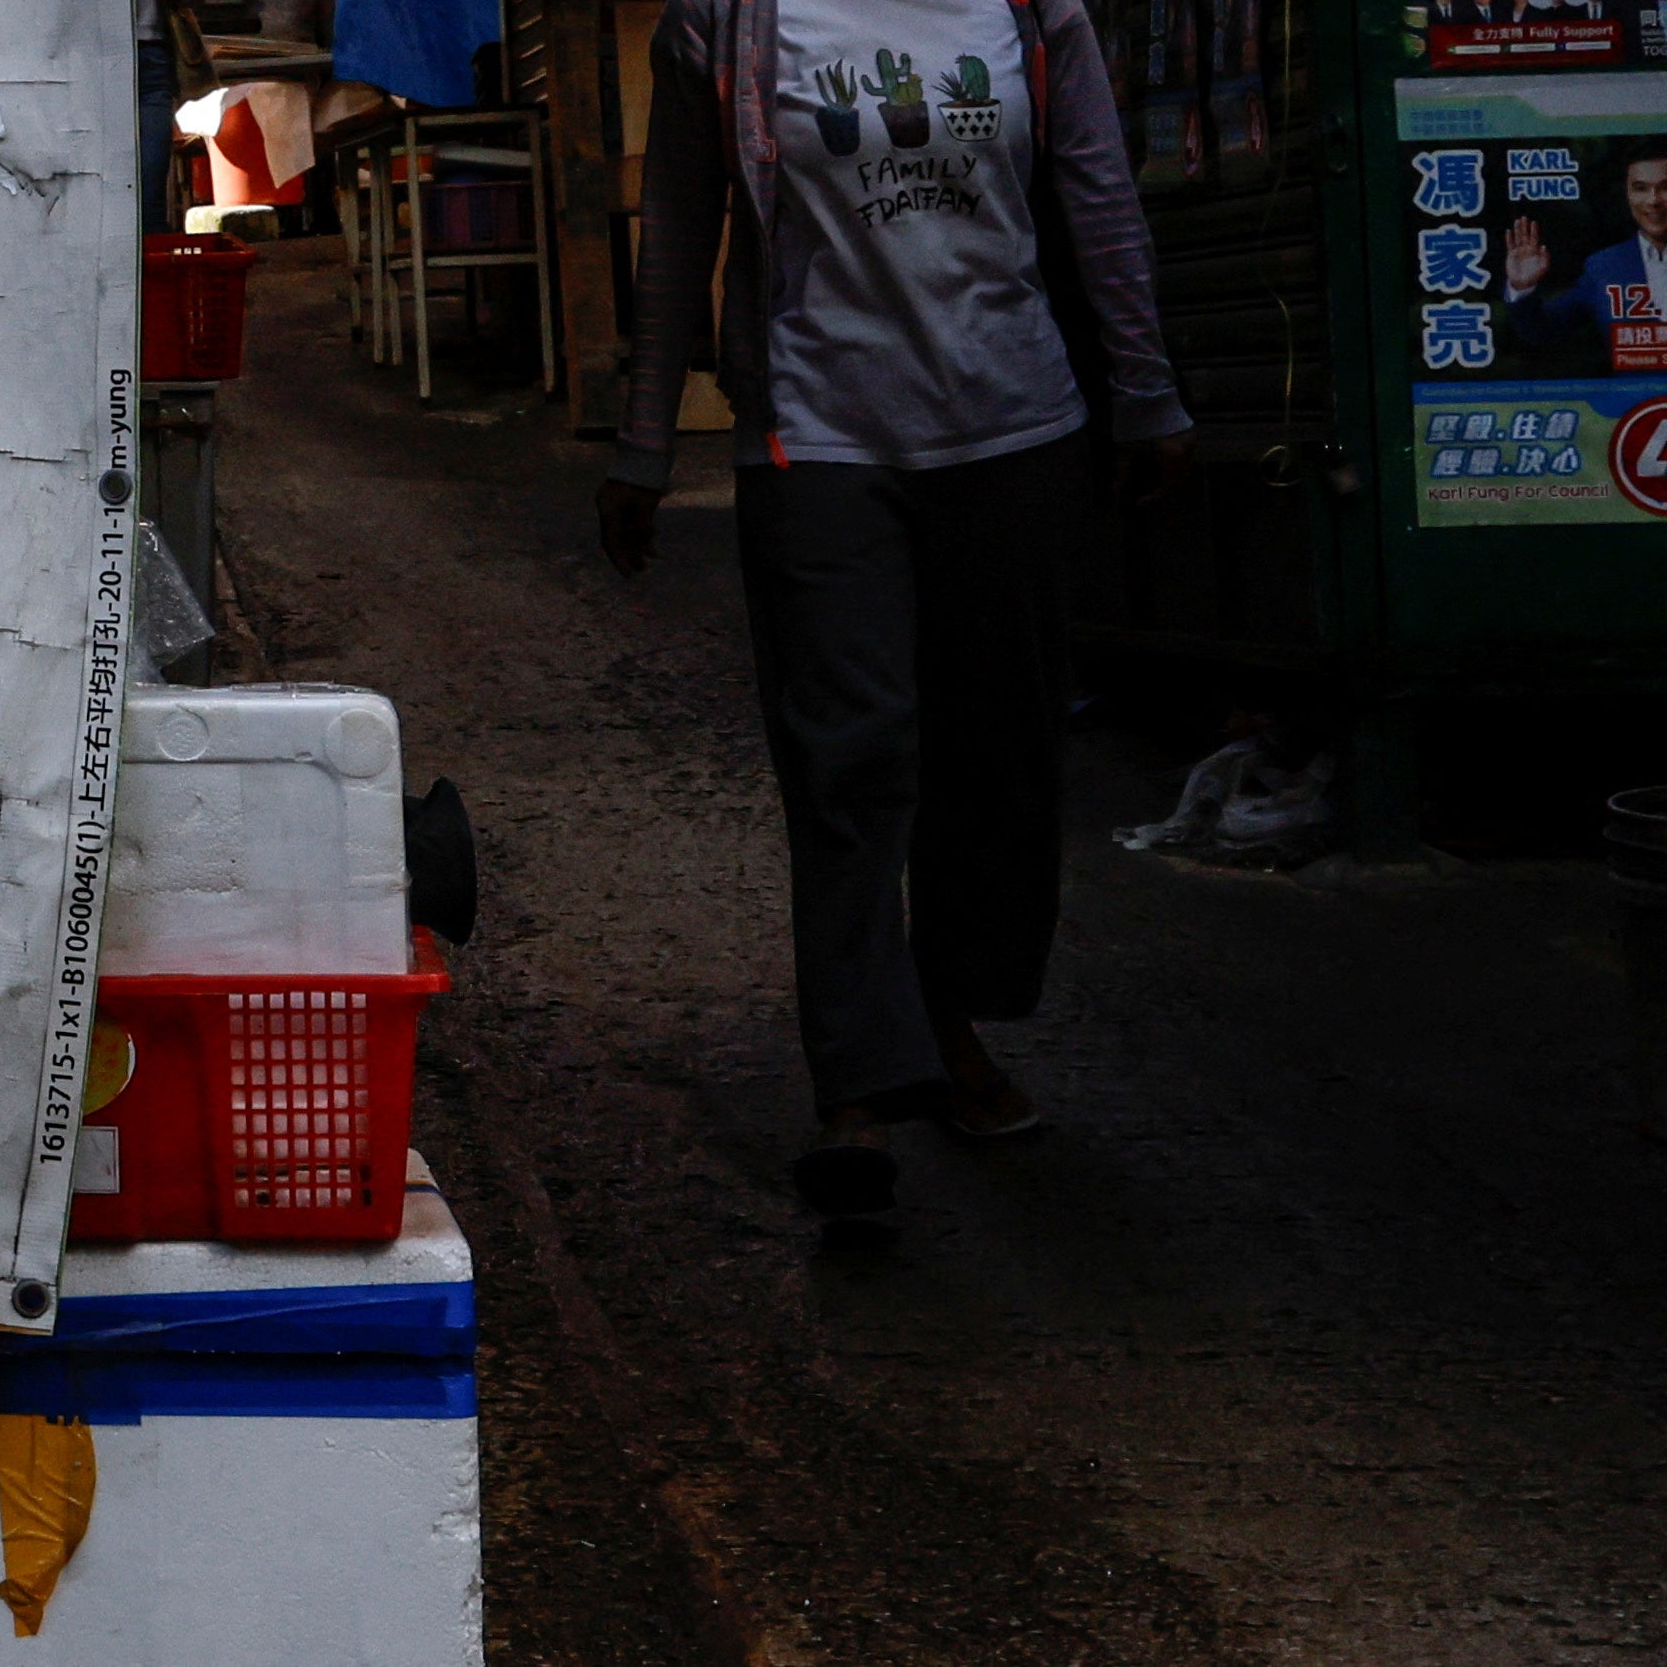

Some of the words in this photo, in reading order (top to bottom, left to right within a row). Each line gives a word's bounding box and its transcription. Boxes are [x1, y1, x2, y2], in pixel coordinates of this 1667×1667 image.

[857, 155, 977, 192] FAMILY
[1507, 148, 1579, 175] KARL
[1508, 175, 1580, 202] FUNG
[1412, 148, 1496, 371] 馮家亮
